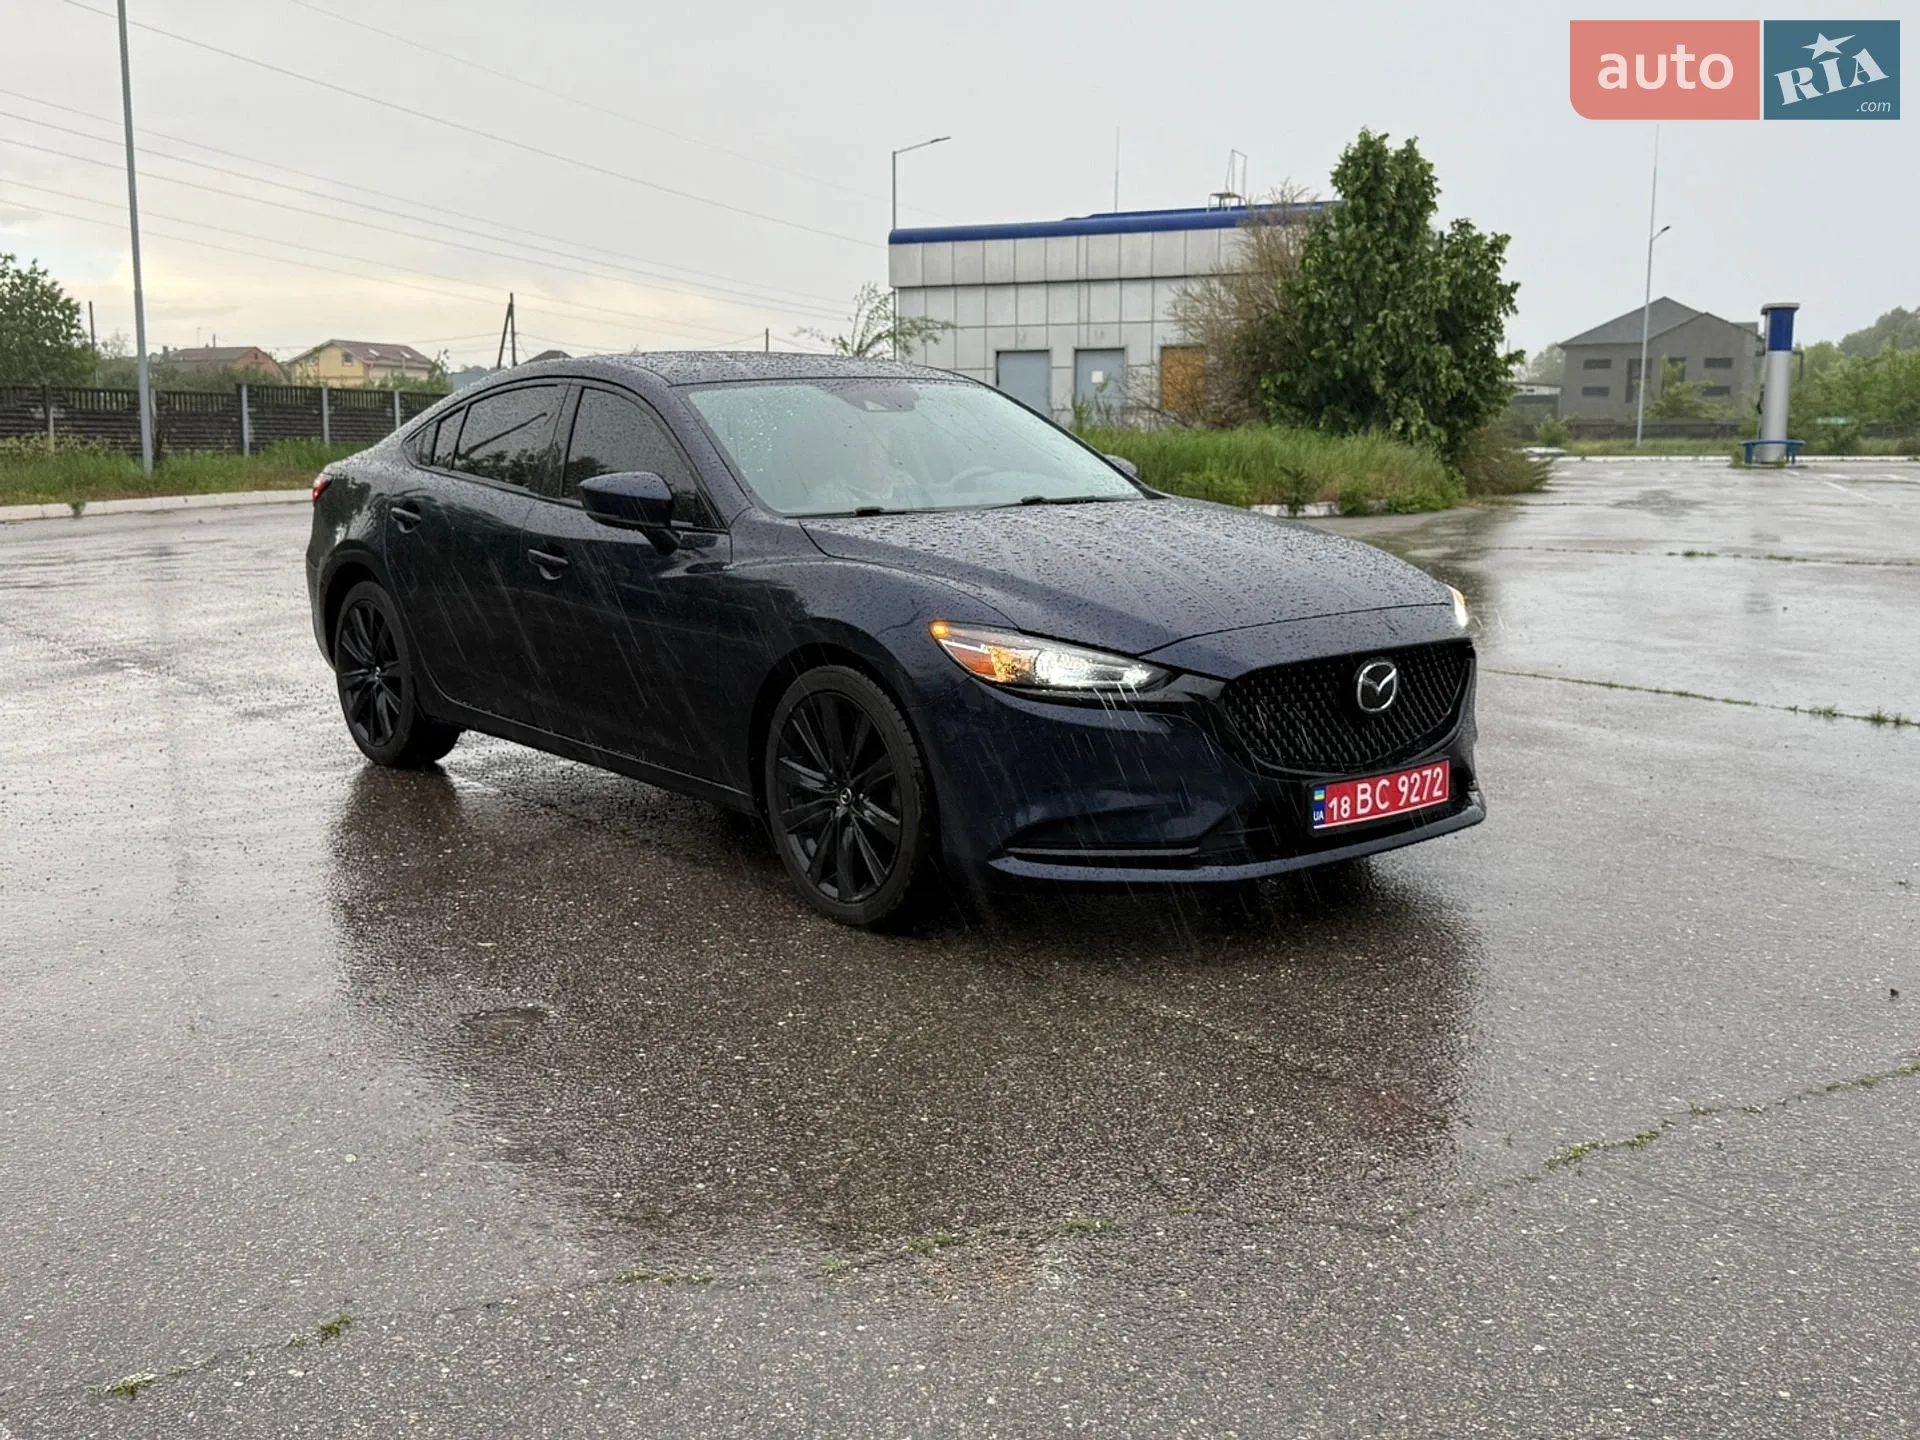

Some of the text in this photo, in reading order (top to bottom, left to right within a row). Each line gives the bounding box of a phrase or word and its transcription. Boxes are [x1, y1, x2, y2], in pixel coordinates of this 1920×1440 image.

[1328, 767, 1443, 820] 18 BC 9272
[1313, 810, 1324, 821] UA
